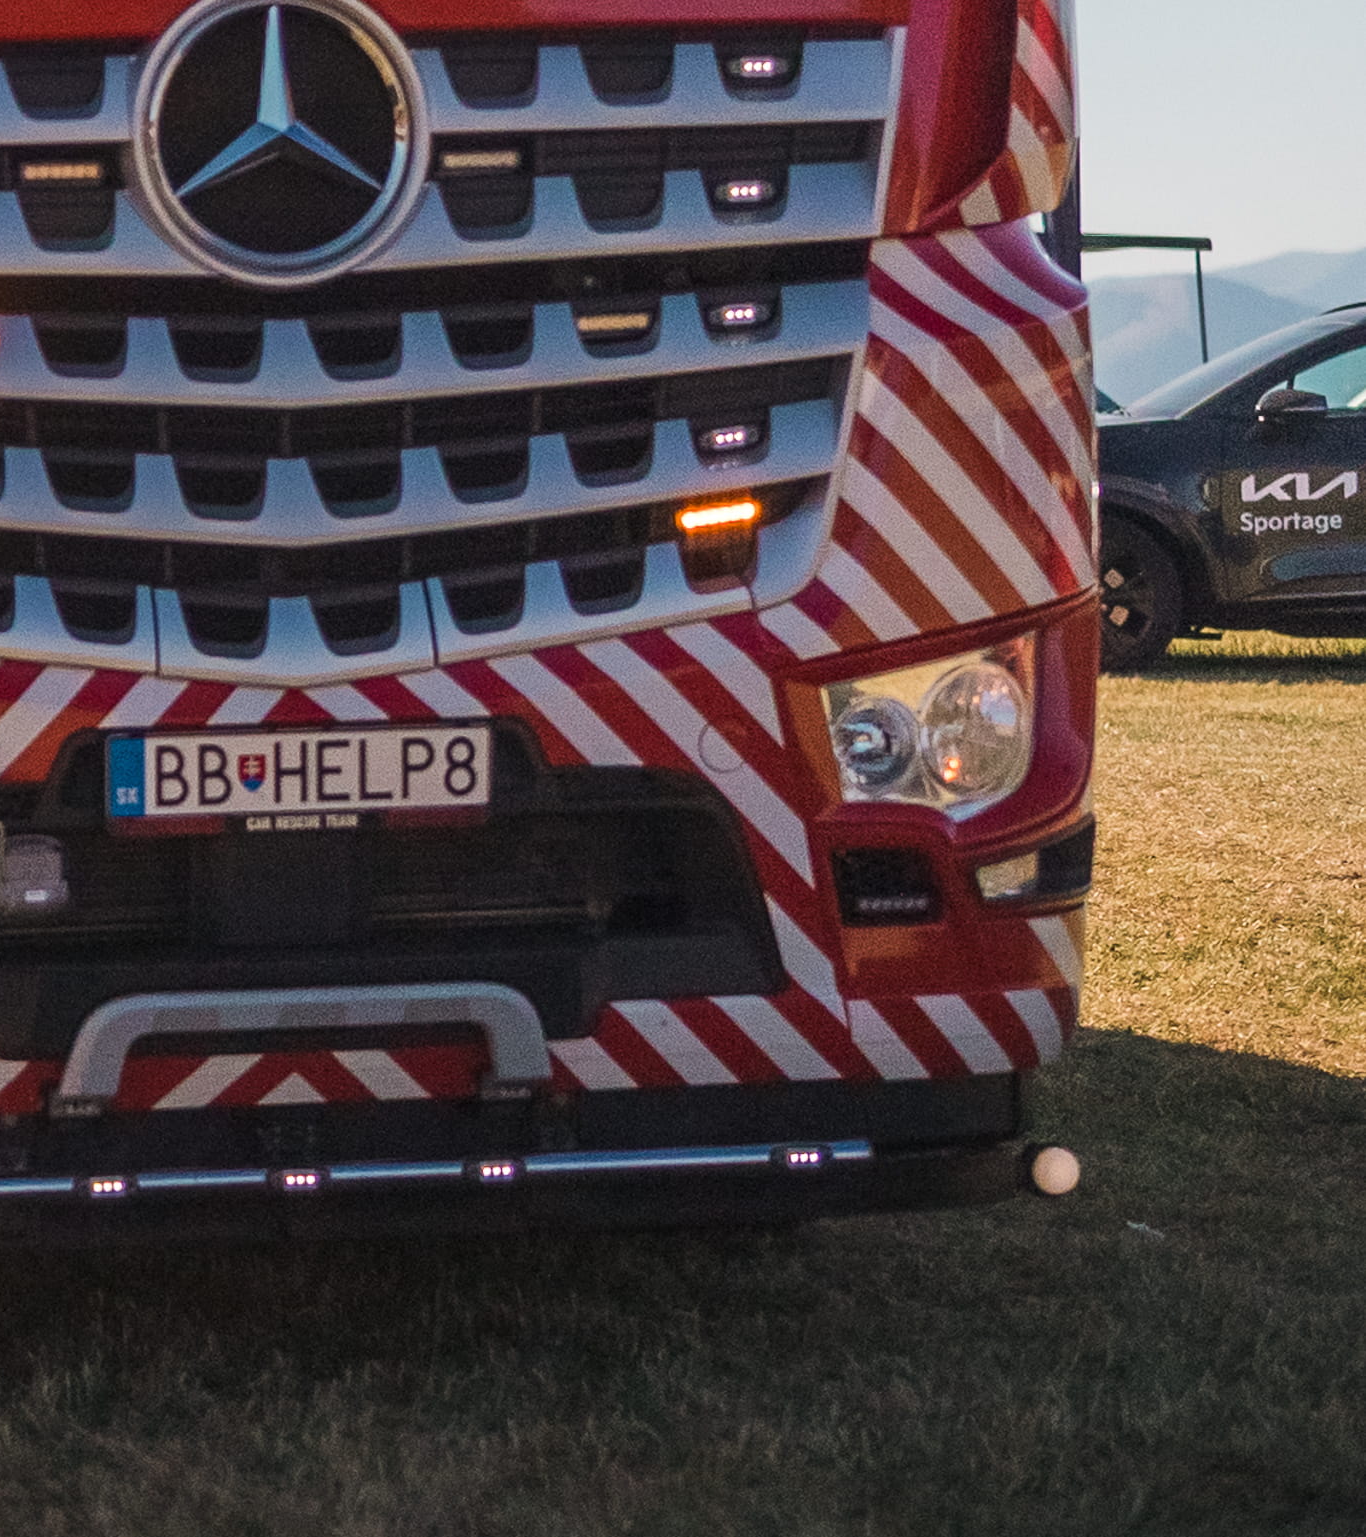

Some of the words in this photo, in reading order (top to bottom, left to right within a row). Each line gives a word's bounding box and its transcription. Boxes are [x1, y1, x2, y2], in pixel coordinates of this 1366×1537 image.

[1241, 471, 1358, 502] KIA
[1240, 512, 1343, 535] Sportage
[154, 743, 232, 806] BB
[272, 735, 478, 804] HELP8
[116, 787, 139, 805] SK
